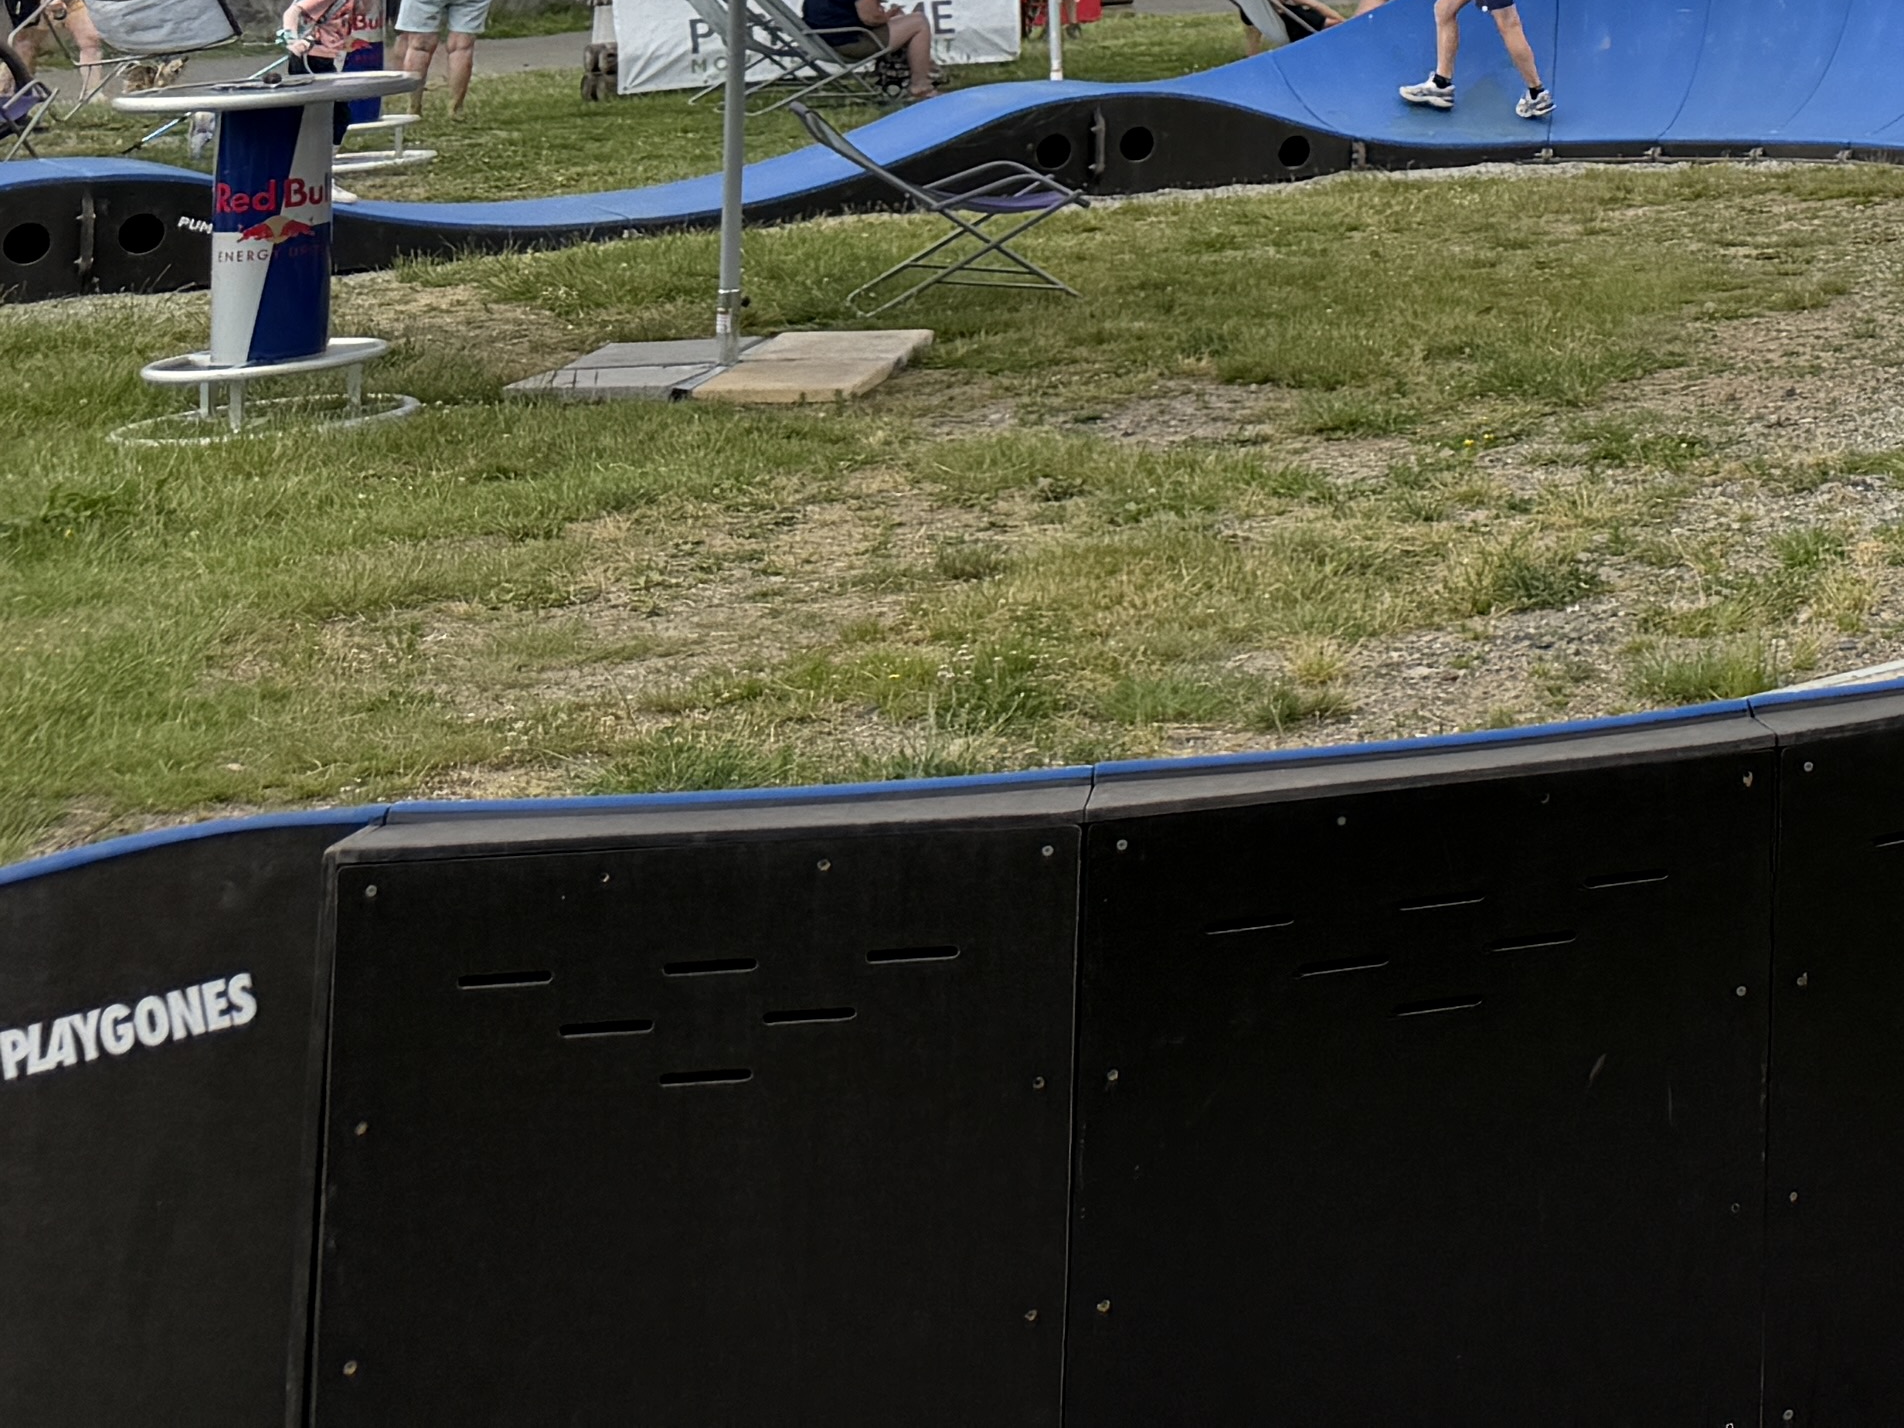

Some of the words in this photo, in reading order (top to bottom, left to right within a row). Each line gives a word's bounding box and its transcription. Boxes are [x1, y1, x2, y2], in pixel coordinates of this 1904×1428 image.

[214, 179, 276, 212] Red
[178, 216, 214, 235] PUM
[0, 973, 258, 1080] PLAYGONES
